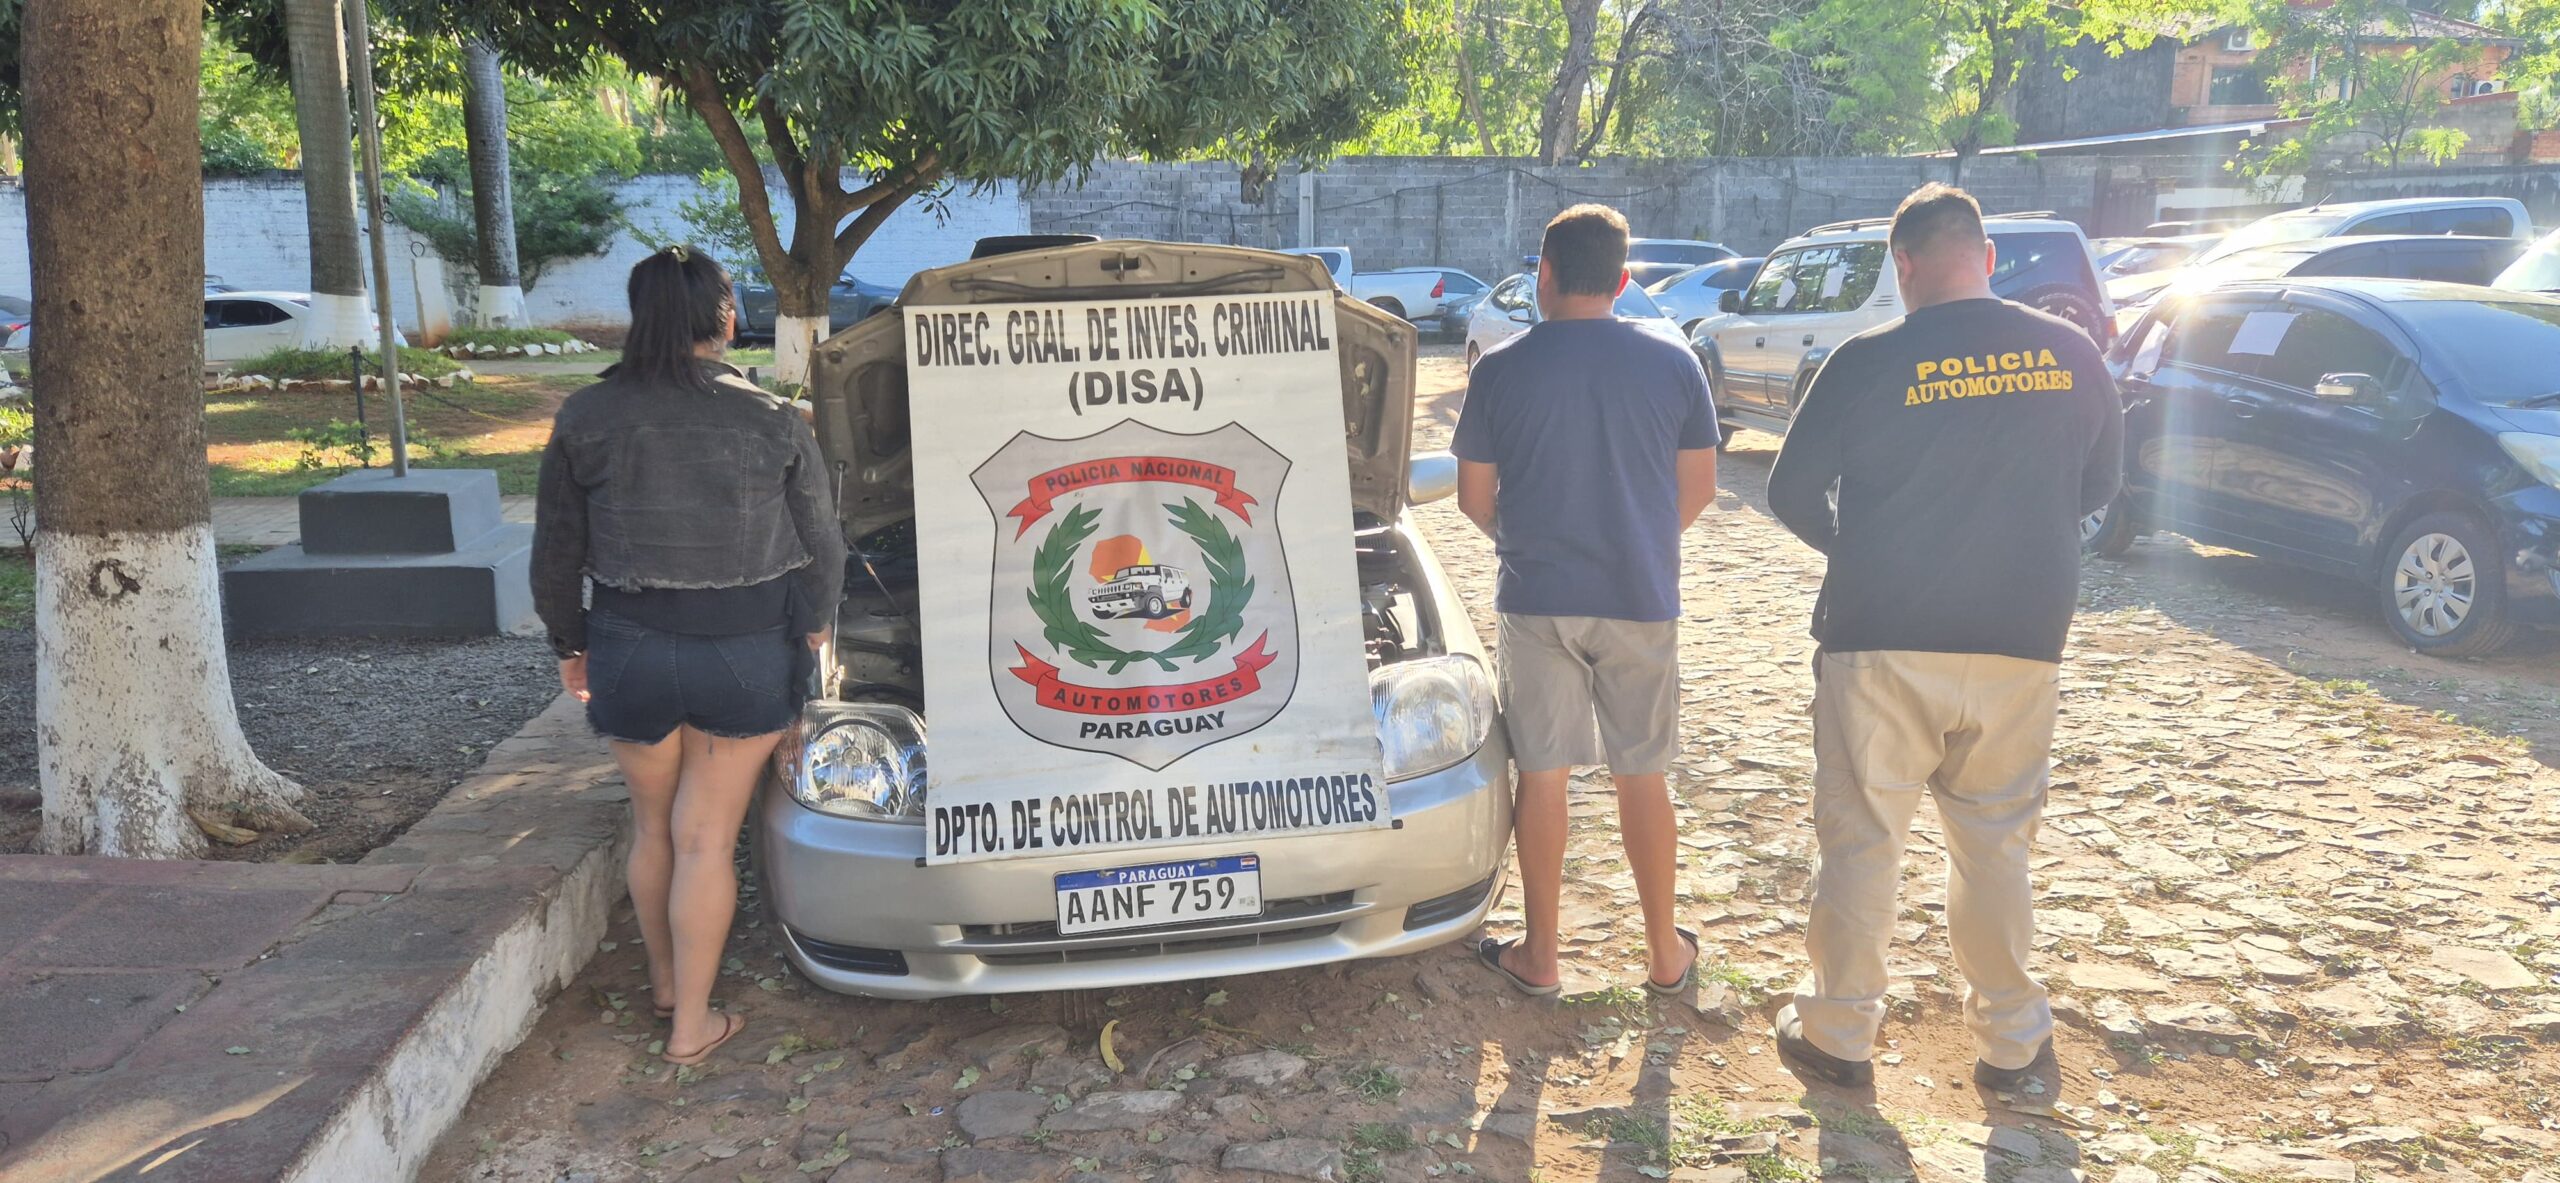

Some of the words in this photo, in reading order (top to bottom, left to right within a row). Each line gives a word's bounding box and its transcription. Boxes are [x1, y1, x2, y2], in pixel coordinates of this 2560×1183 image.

[915, 311, 1000, 367] DIREC.
[1006, 308, 1080, 364] GRAL.
[1088, 306, 1120, 361] DE
[1126, 302, 1207, 360] INVES.
[1213, 299, 1330, 356] CRIMINAL
[1916, 349, 2058, 381] POLICIA
[1068, 366, 1204, 417] (DISA)
[1904, 370, 2073, 406] AUTOMOTORES
[1045, 463, 1120, 492] POLICIA
[1131, 461, 1223, 485] NACIONAL
[1053, 676, 1243, 712] AUTOMOTORES
[1079, 710, 1225, 740] PARAGUAY
[934, 802, 1005, 857] DPTO.
[1011, 798, 1043, 850] DE
[1049, 788, 1163, 849] CONTROL
[1169, 785, 1200, 838] DE
[1205, 773, 1378, 835] AUTOMOTORES
[1118, 864, 1196, 884] PARAGUAY
[1067, 883, 1156, 926] AANF
[1168, 876, 1236, 915] 759
